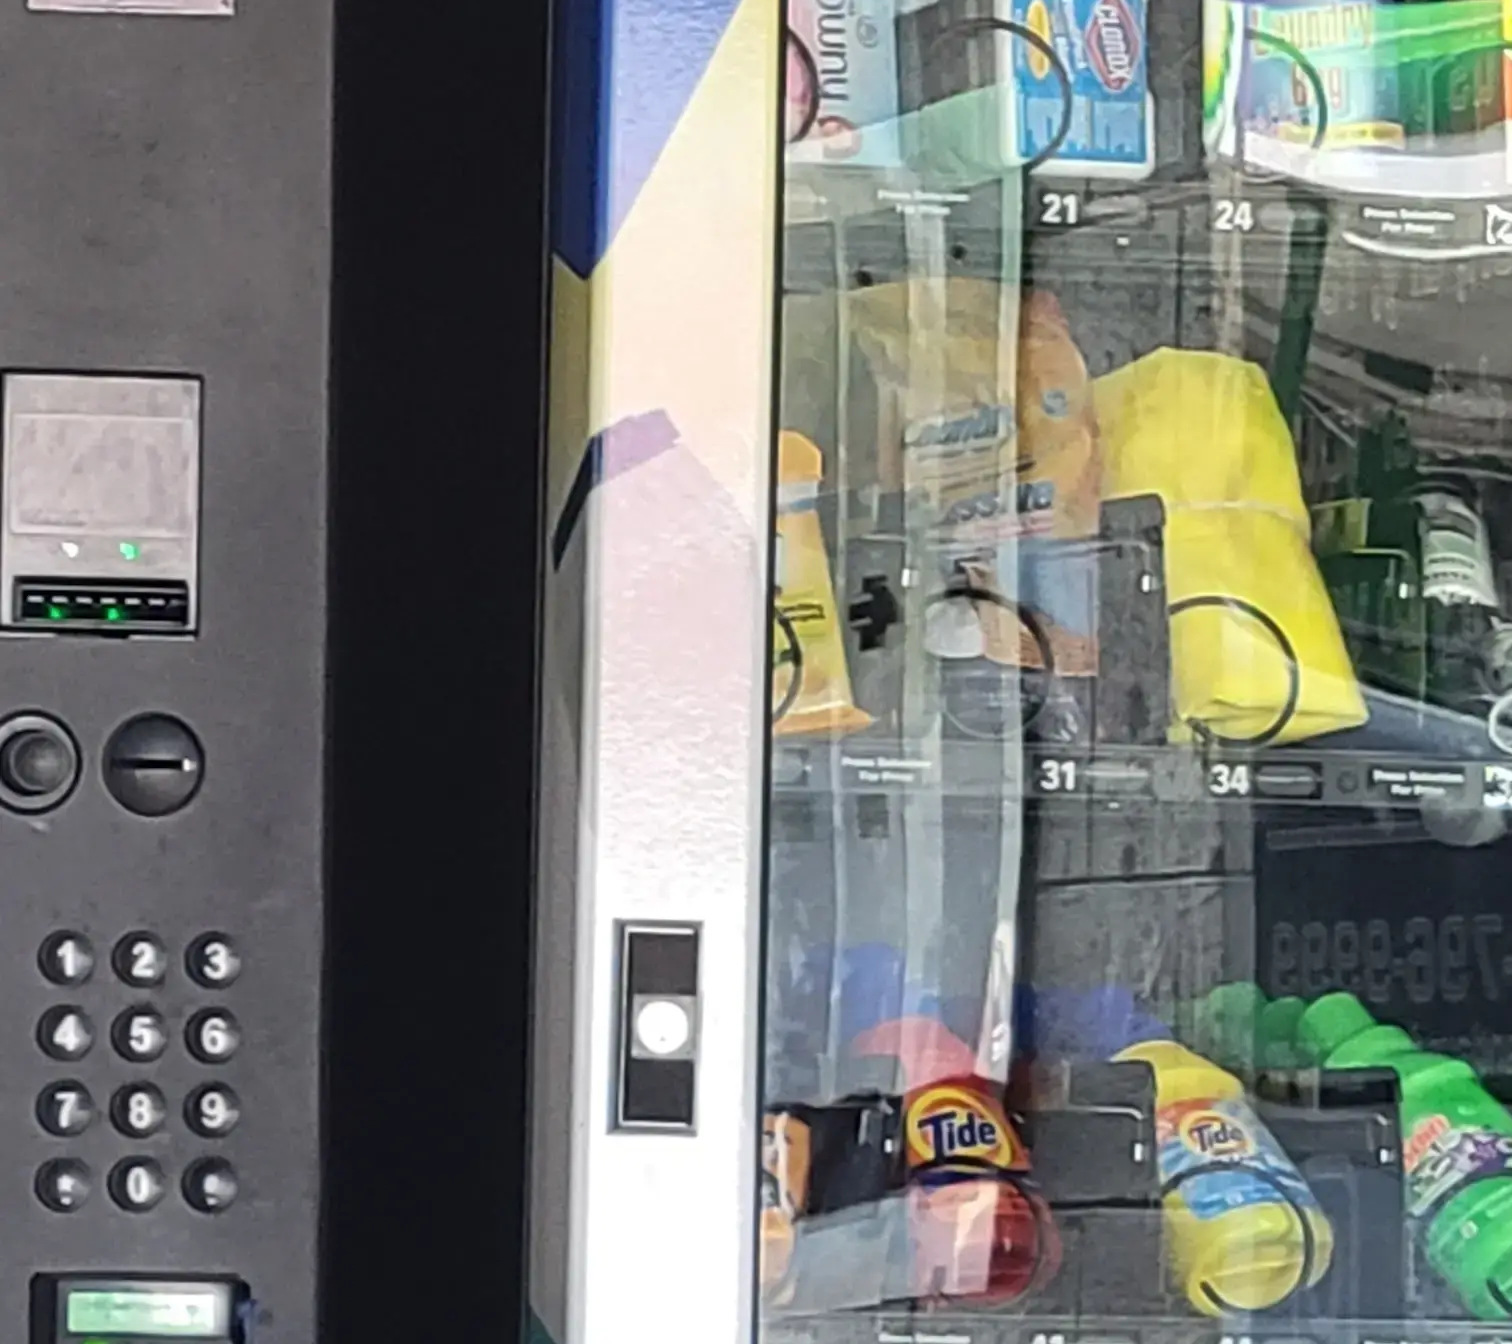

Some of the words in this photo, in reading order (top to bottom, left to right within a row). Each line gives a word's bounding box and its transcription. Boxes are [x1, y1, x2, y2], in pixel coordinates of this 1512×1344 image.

[1094, 4, 1132, 80] CLOROX
[1041, 194, 1079, 224] 21
[1214, 200, 1253, 232] 24
[1040, 760, 1077, 791] 31
[1209, 764, 1250, 795] 34
[56, 939, 75, 977] 1
[131, 941, 154, 977] 2
[203, 942, 228, 980] 3
[53, 1014, 80, 1052] 4
[129, 1015, 154, 1053] 5
[201, 1017, 227, 1054] 6
[54, 1092, 78, 1128] 7
[128, 1092, 152, 1130] 8
[200, 1092, 226, 1128] 9
[918, 1113, 997, 1162] Tide
[1188, 1121, 1244, 1153] Tide
[126, 1166, 150, 1204] 0
